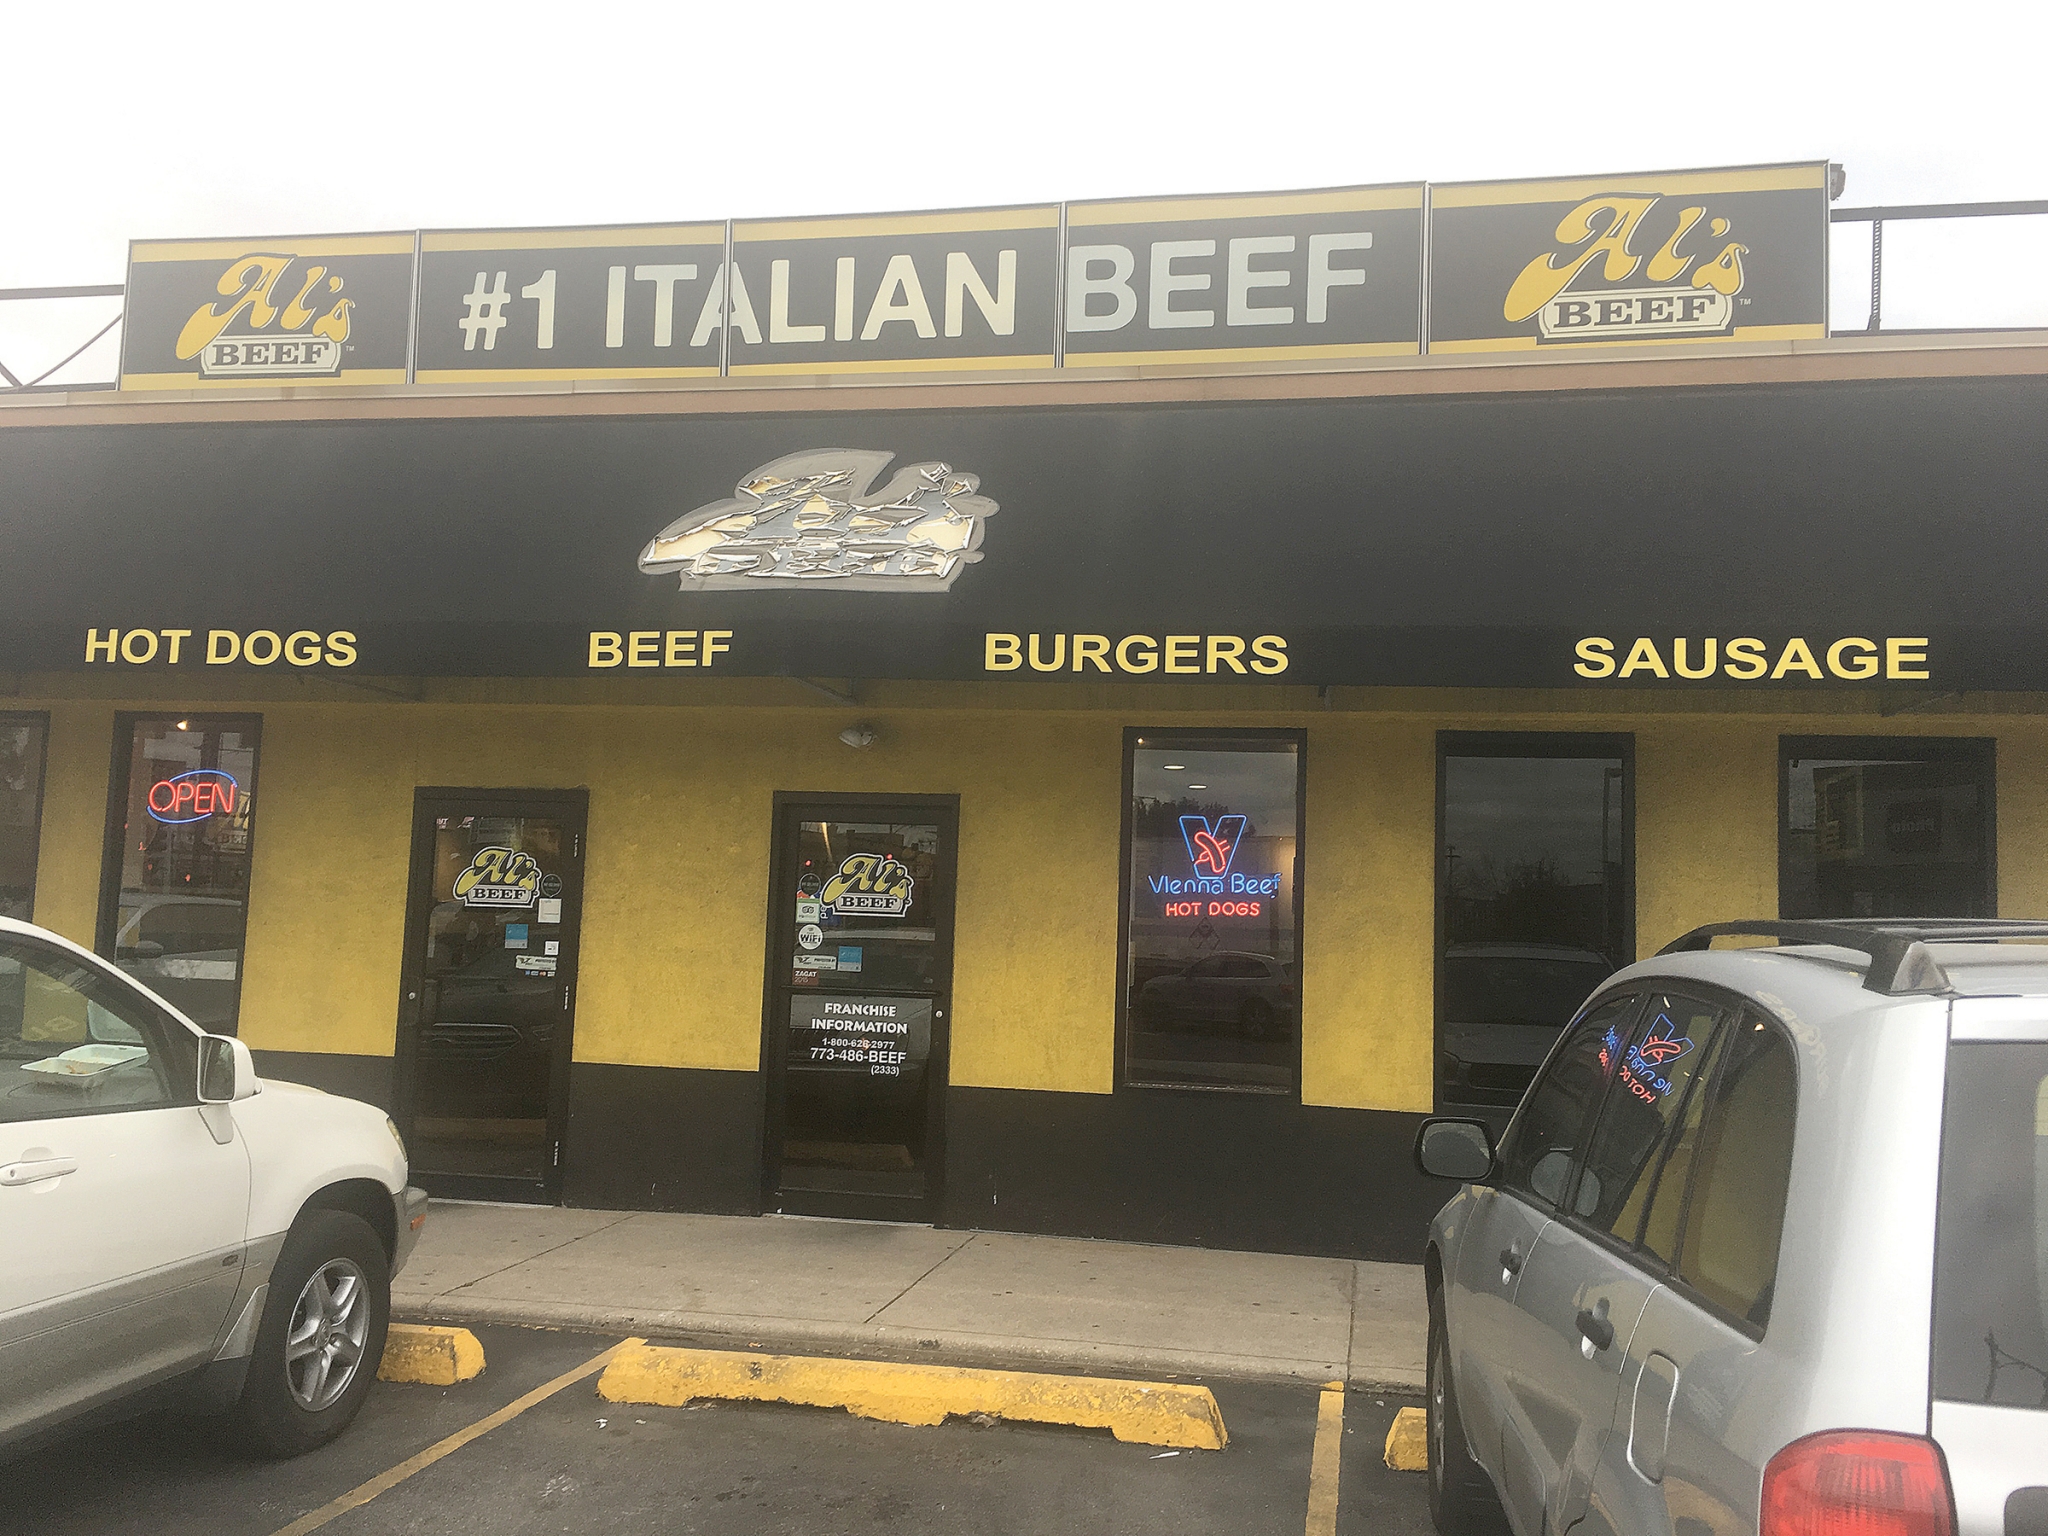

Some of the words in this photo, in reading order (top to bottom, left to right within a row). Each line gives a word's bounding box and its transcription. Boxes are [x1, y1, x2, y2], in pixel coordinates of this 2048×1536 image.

[1503, 191, 1749, 323] Al's
[175, 254, 356, 361] Al's
[458, 269, 557, 351] #1
[605, 249, 1017, 348] ITALIAN
[1065, 232, 1373, 333] BEEF
[1553, 295, 1716, 328] BEEF
[211, 341, 329, 366] BEEF
[84, 628, 191, 665] HOT
[205, 629, 358, 667] DOGS
[588, 630, 734, 668] BEEF
[984, 633, 1290, 675] BURGERS
[1573, 636, 1931, 682] SAUSAGE
[148, 780, 236, 814] OPEN
[456, 849, 538, 895] Al's
[823, 856, 912, 903] Al's
[1231, 873, 1282, 899] Beef
[473, 888, 526, 899] BEEF
[841, 896, 899, 909] BEEF
[1166, 902, 1202, 917] HOT
[1208, 901, 1260, 917] DOGS
[811, 1018, 908, 1035] INFORMATION
[824, 1002, 897, 1018] FRANCHISE
[810, 1047, 907, 1065] 773-486-BEEF
[870, 1065, 900, 1077] (2333)
